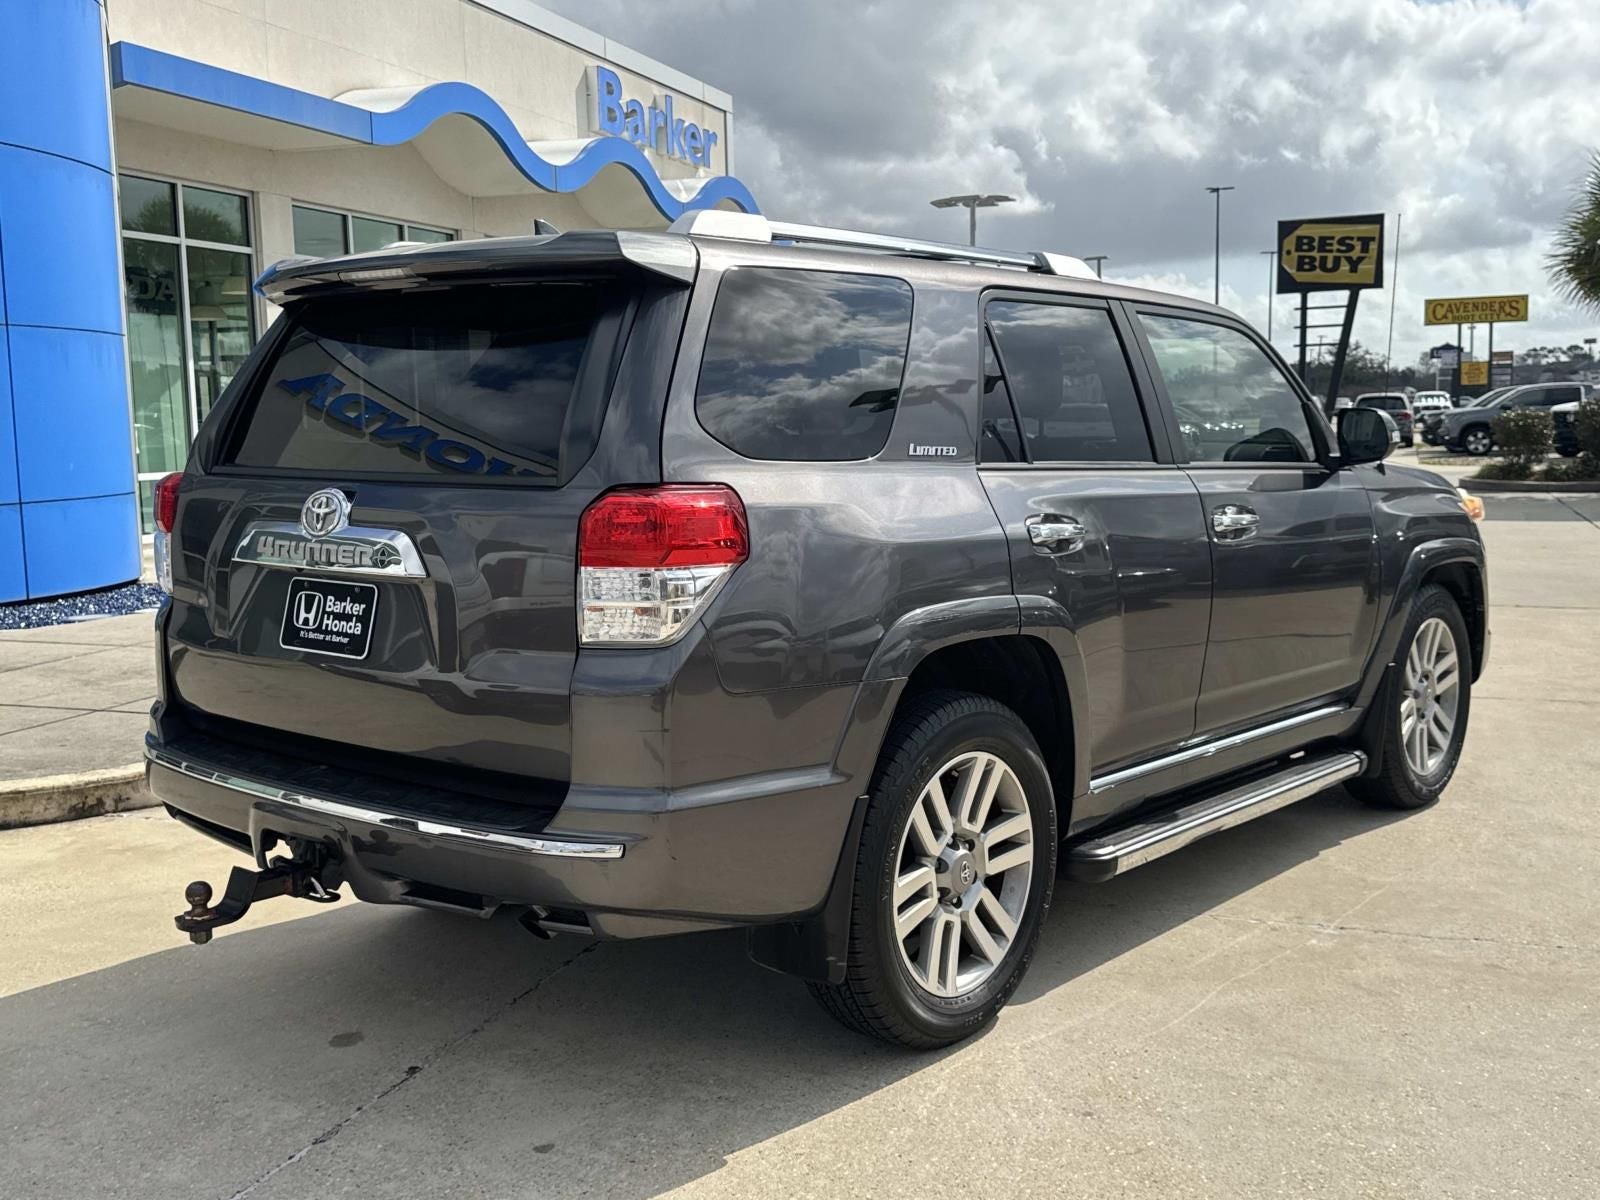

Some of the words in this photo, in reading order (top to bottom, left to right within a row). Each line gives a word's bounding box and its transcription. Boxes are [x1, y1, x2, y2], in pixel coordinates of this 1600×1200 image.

[597, 65, 718, 168] Barker
[1294, 235, 1376, 254] BEST
[1296, 254, 1368, 273] BUY
[325, 595, 366, 616] Barker
[322, 613, 362, 635] Honda
[308, 632, 325, 641] Better
[332, 635, 350, 643] Barker
